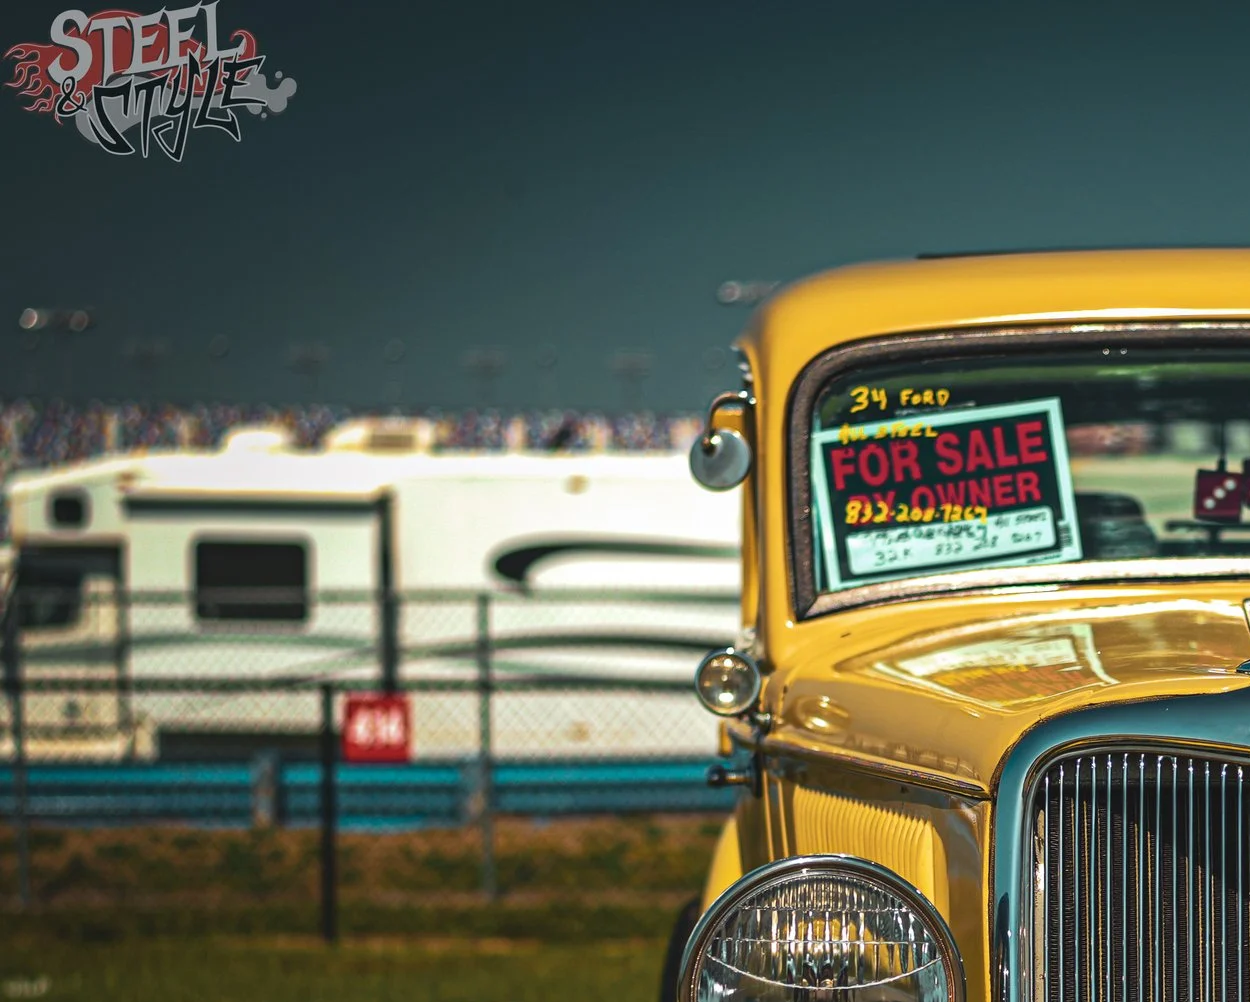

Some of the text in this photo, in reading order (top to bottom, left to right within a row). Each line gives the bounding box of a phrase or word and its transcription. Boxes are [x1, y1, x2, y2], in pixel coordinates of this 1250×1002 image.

[850, 386, 950, 413] 34 FORD
[831, 420, 1048, 491] FOR SALE
[911, 470, 1042, 511] OWNER
